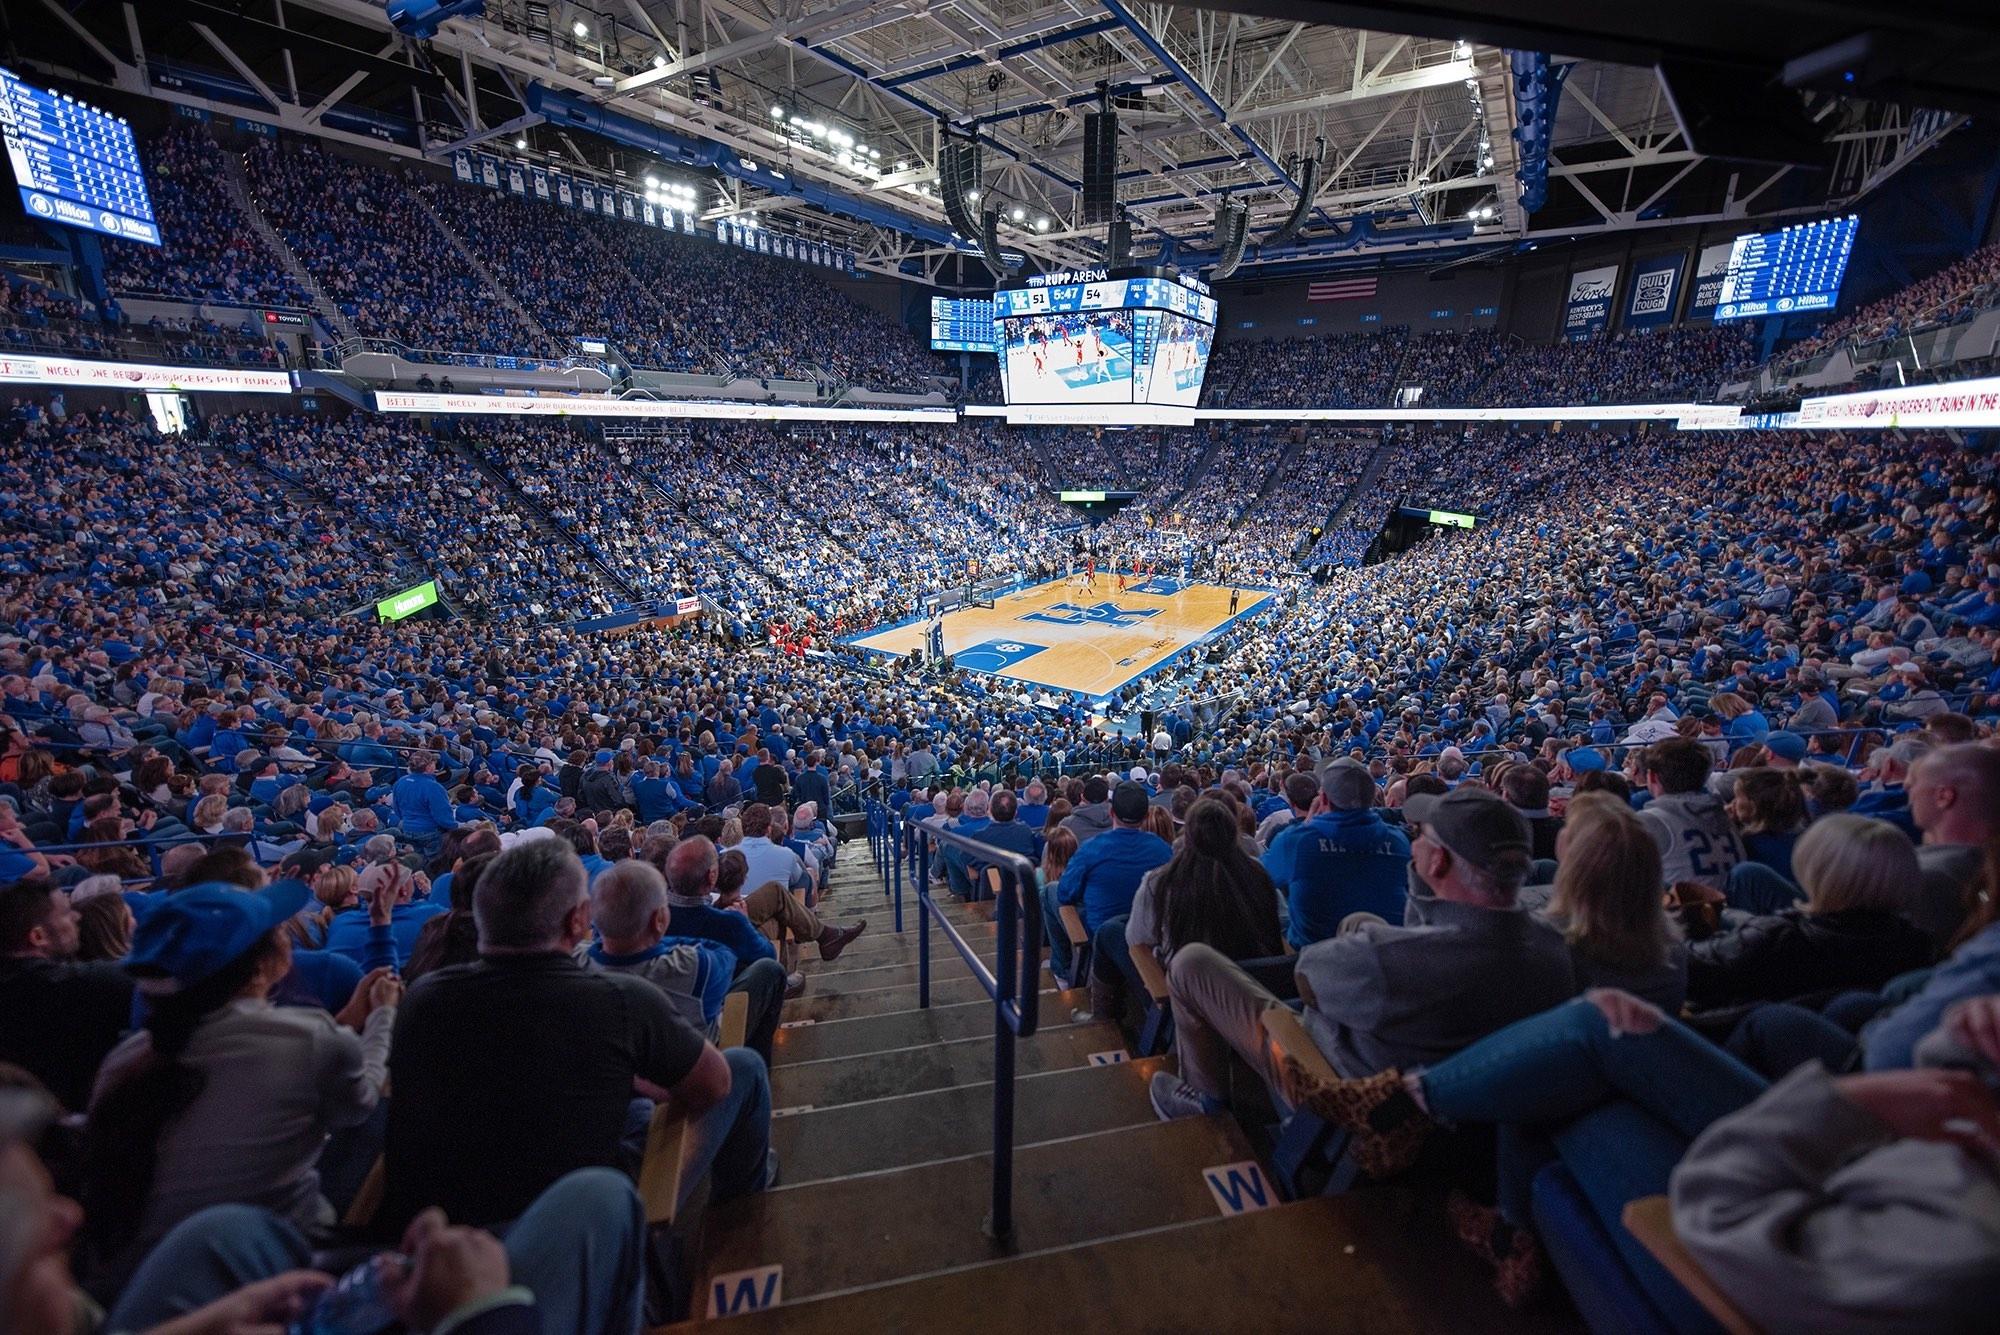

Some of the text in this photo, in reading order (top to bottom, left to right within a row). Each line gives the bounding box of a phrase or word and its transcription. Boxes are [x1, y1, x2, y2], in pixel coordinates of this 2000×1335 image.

[9, 139, 22, 151] 54
[54, 199, 91, 221] Hilton
[121, 217, 152, 236] Hilton
[1045, 270, 1108, 286] RUPP ARENA
[1640, 273, 1671, 288] BUILT
[1053, 287, 1078, 300] 5:47
[1086, 290, 1101, 299] 54
[1572, 280, 1613, 301] Ford
[1644, 289, 1662, 298] Ford
[1697, 289, 1718, 299] BUILT
[1033, 294, 1044, 304] 51
[1636, 298, 1665, 310] TOUGH
[1798, 295, 1828, 306] Hilton
[1570, 303, 1604, 314] KENTUCKY'S
[1740, 302, 1768, 313] Hilton
[279, 315, 302, 323] TOYOTA
[1568, 310, 1605, 321] BEST-SELLING
[46, 366, 80, 376] NICELY
[1923, 397, 1940, 413] PUT
[1940, 396, 1965, 412] BUNS
[1965, 394, 1978, 411] IN
[1978, 393, 1999, 410] THE
[679, 600, 701, 610] ESPN
[1683, 829, 1740, 876] 23
[1207, 1165, 1269, 1212] W
[714, 1272, 778, 1317] W
